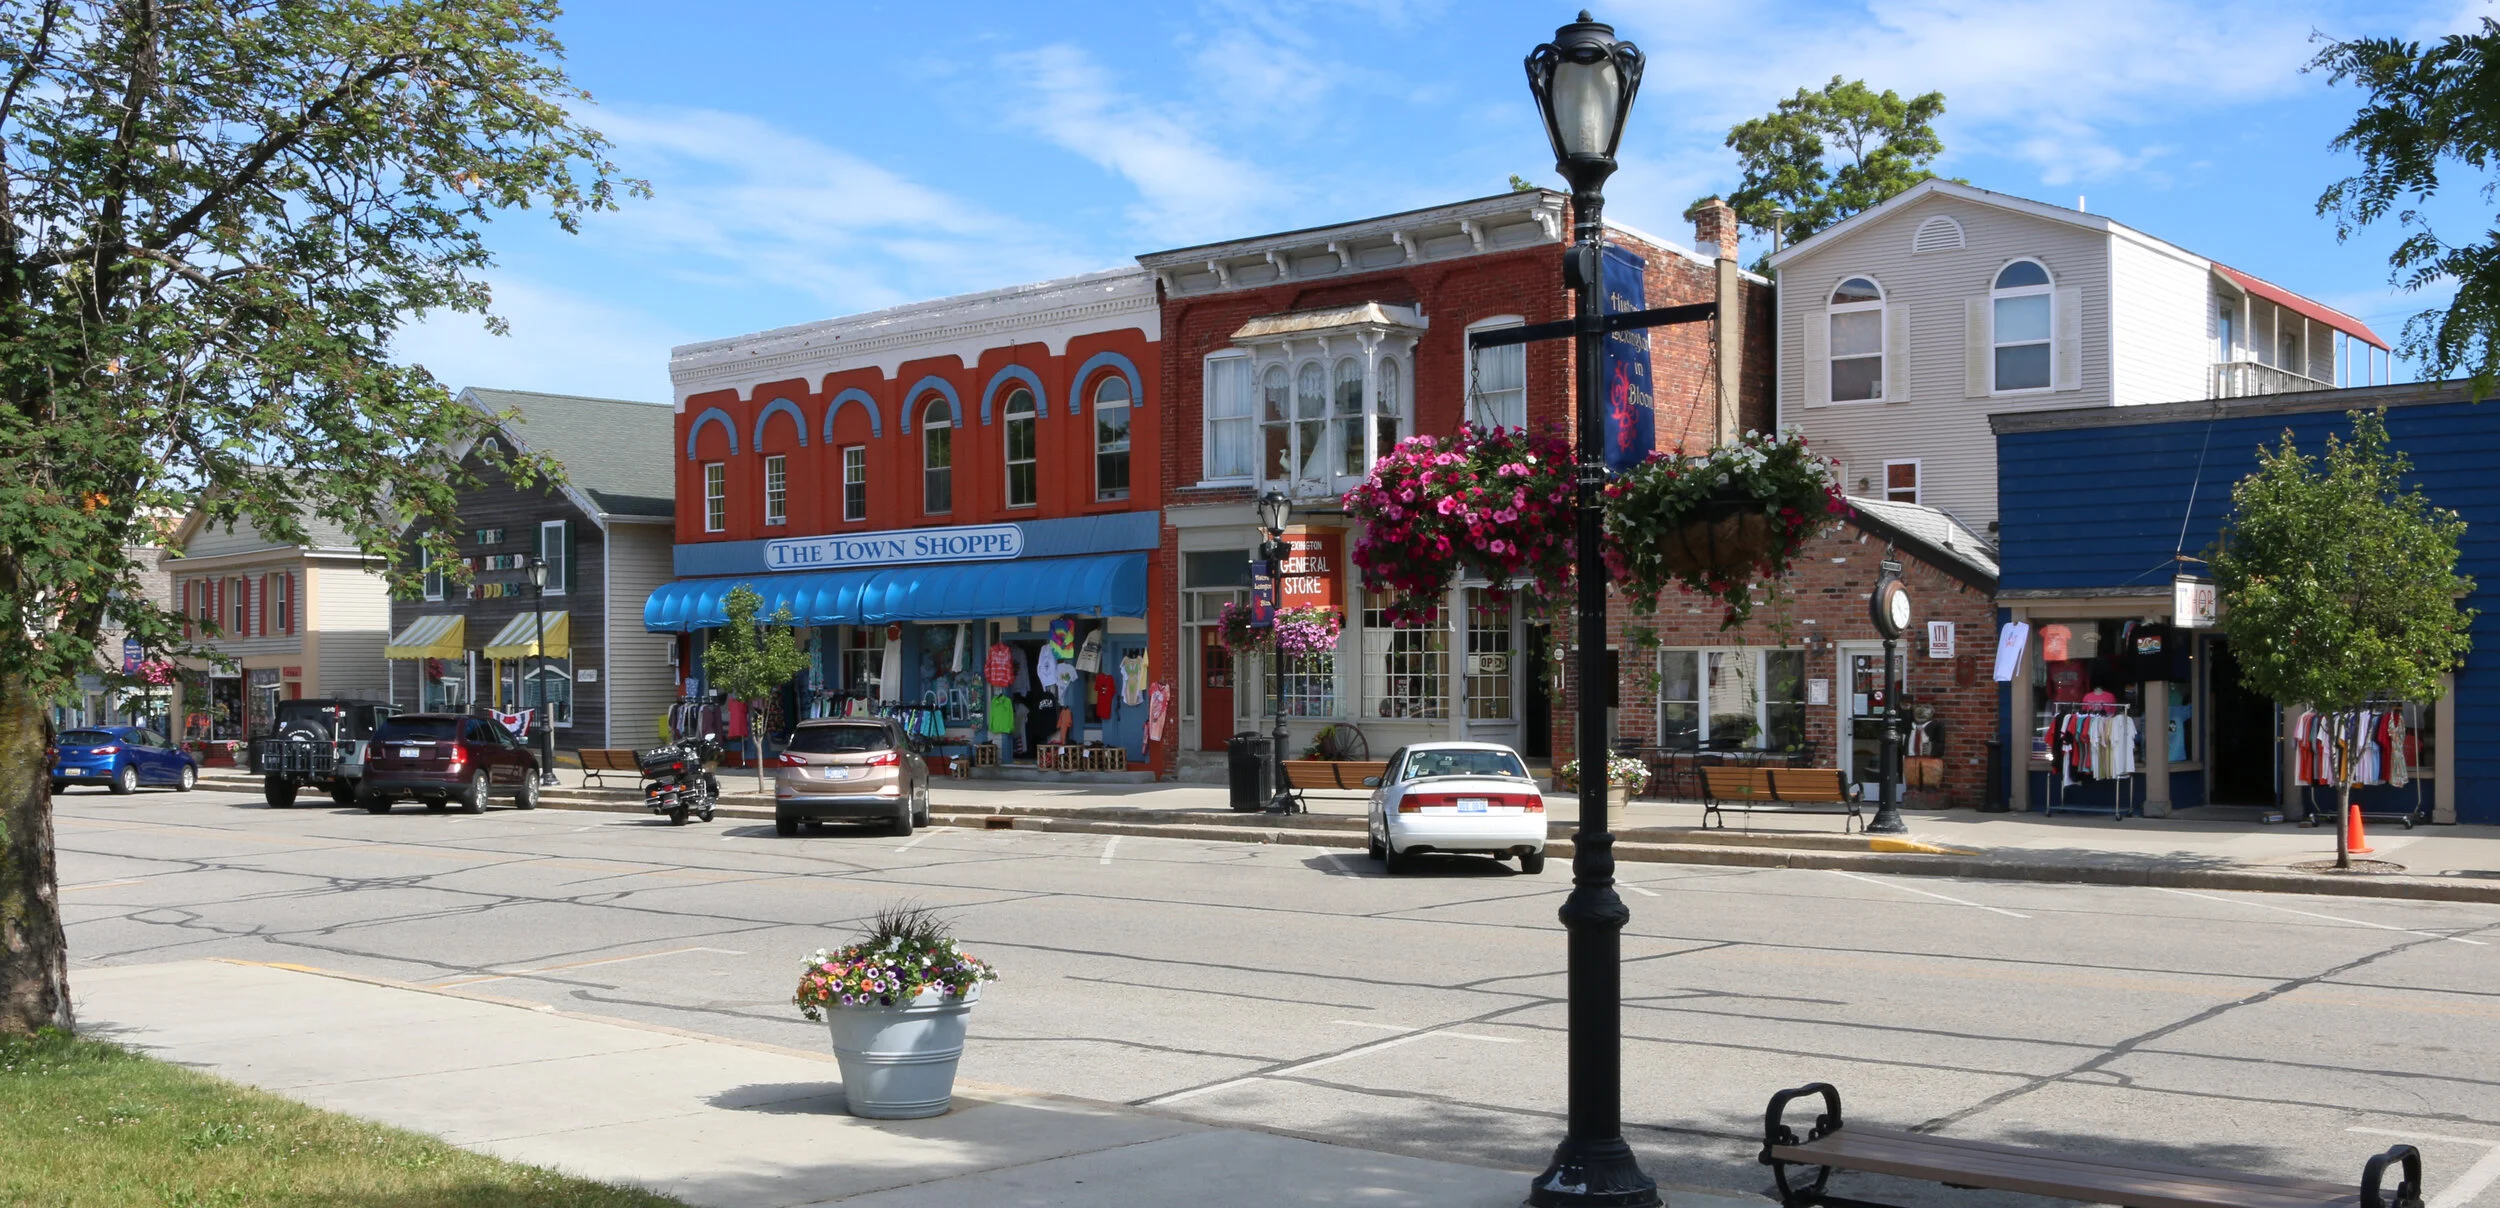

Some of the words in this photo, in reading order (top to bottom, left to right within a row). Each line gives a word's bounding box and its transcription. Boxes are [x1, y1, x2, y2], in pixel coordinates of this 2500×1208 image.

[1611, 291, 1641, 313] Histor
[1633, 357, 1644, 376] in
[476, 528, 504, 544] THE
[771, 545, 823, 564] THE
[829, 539, 906, 560] TOWN
[914, 533, 1013, 556] SHOPPE
[462, 554, 524, 572] PANTED
[1280, 557, 1330, 573] GENERAL
[1284, 576, 1322, 594] STORE
[1933, 625, 1948, 641] ATM
[1481, 657, 1505, 669] OPEN
